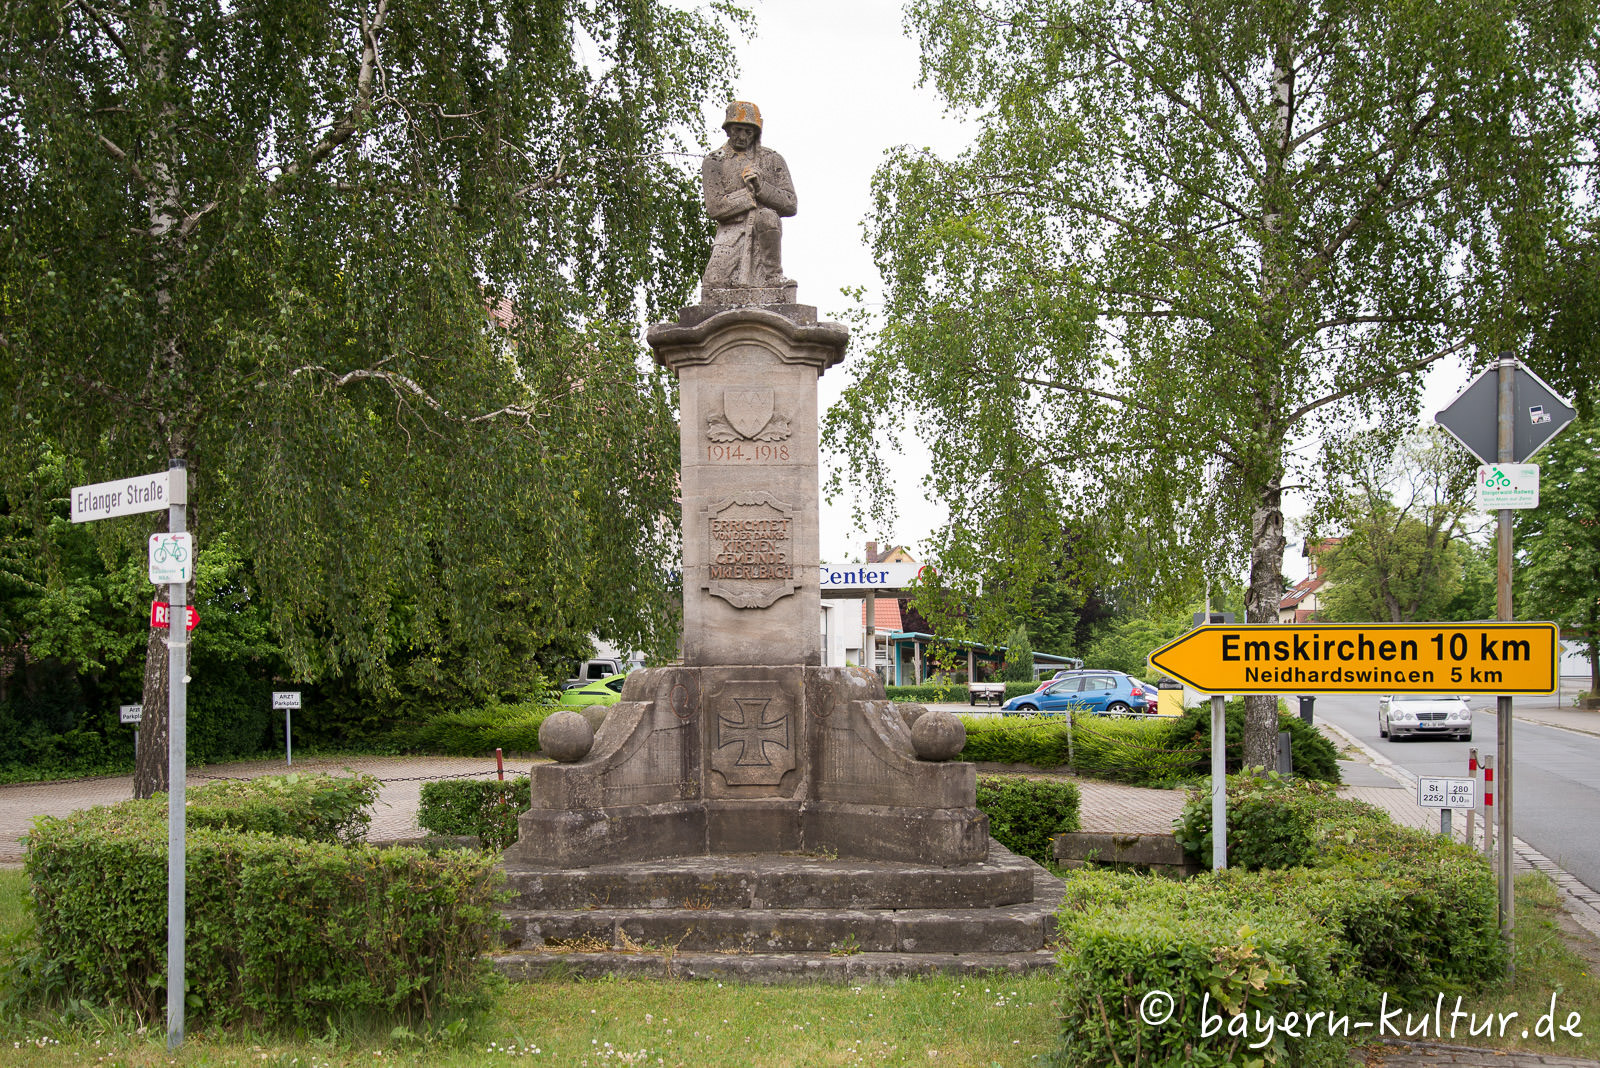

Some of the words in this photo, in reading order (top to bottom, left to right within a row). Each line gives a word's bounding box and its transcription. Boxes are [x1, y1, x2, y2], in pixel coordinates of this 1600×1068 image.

[77, 491, 122, 514] Erlanger
[127, 480, 163, 505] Straße
[712, 520, 790, 532] ERRICHTET
[713, 531, 732, 541] VON
[733, 531, 753, 541] DER
[715, 552, 786, 565] GEMEINDE
[180, 567, 185, 579] 1
[734, 565, 794, 580] ERLBACH
[155, 605, 193, 626] REE
[1222, 633, 1418, 661] Emskirchen
[1430, 633, 1468, 661] 10
[1481, 633, 1531, 661] km
[1450, 667, 1463, 683] 5
[1470, 666, 1503, 683] km
[1429, 784, 1439, 792] St
[1453, 785, 1469, 793] 280
[1423, 794, 1444, 802] 2252
